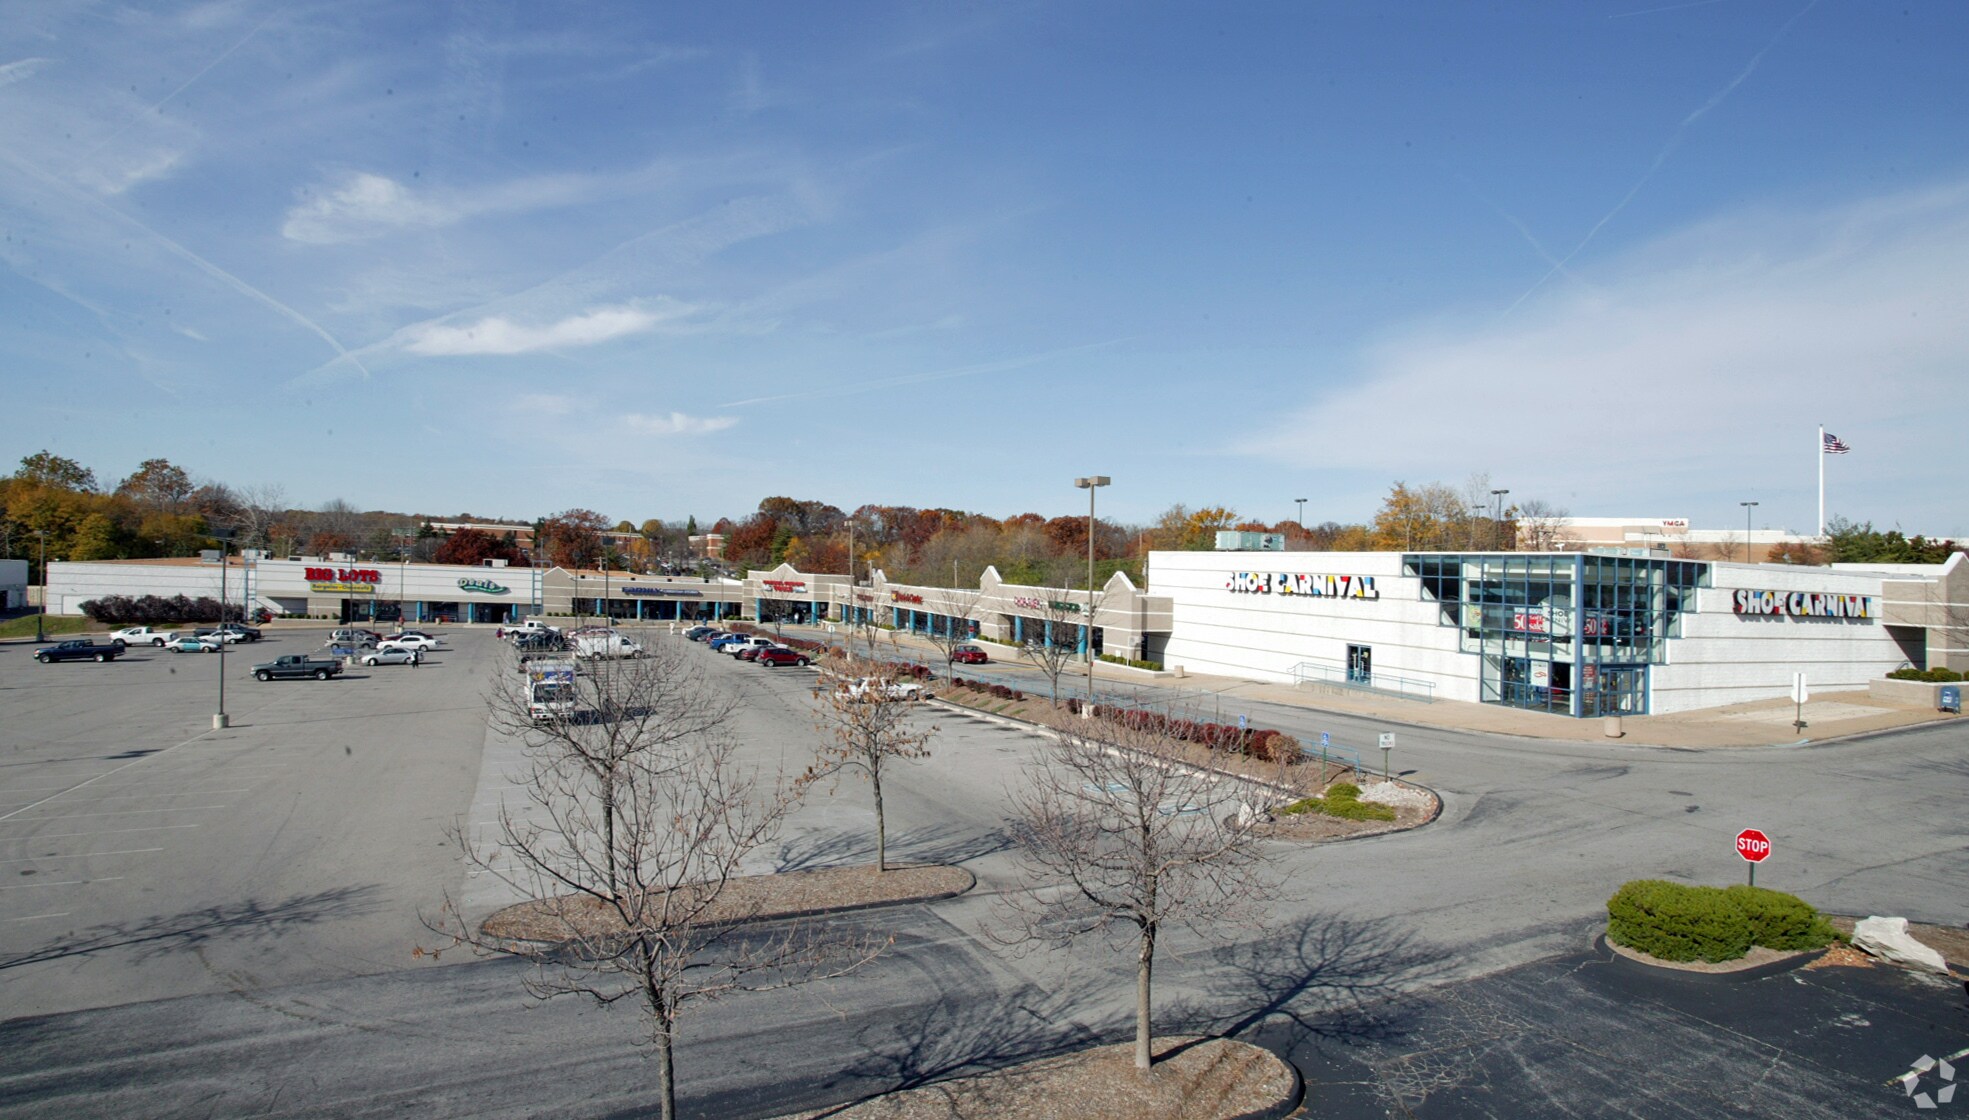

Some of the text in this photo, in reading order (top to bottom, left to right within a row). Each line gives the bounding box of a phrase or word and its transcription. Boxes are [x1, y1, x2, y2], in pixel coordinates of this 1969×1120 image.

[304, 567, 380, 583] BIG LOTS
[1226, 571, 1379, 600] SHOE CARNIVAL
[1733, 588, 1872, 618] SHOE CARNIVAL
[1738, 838, 1768, 852] STOP
